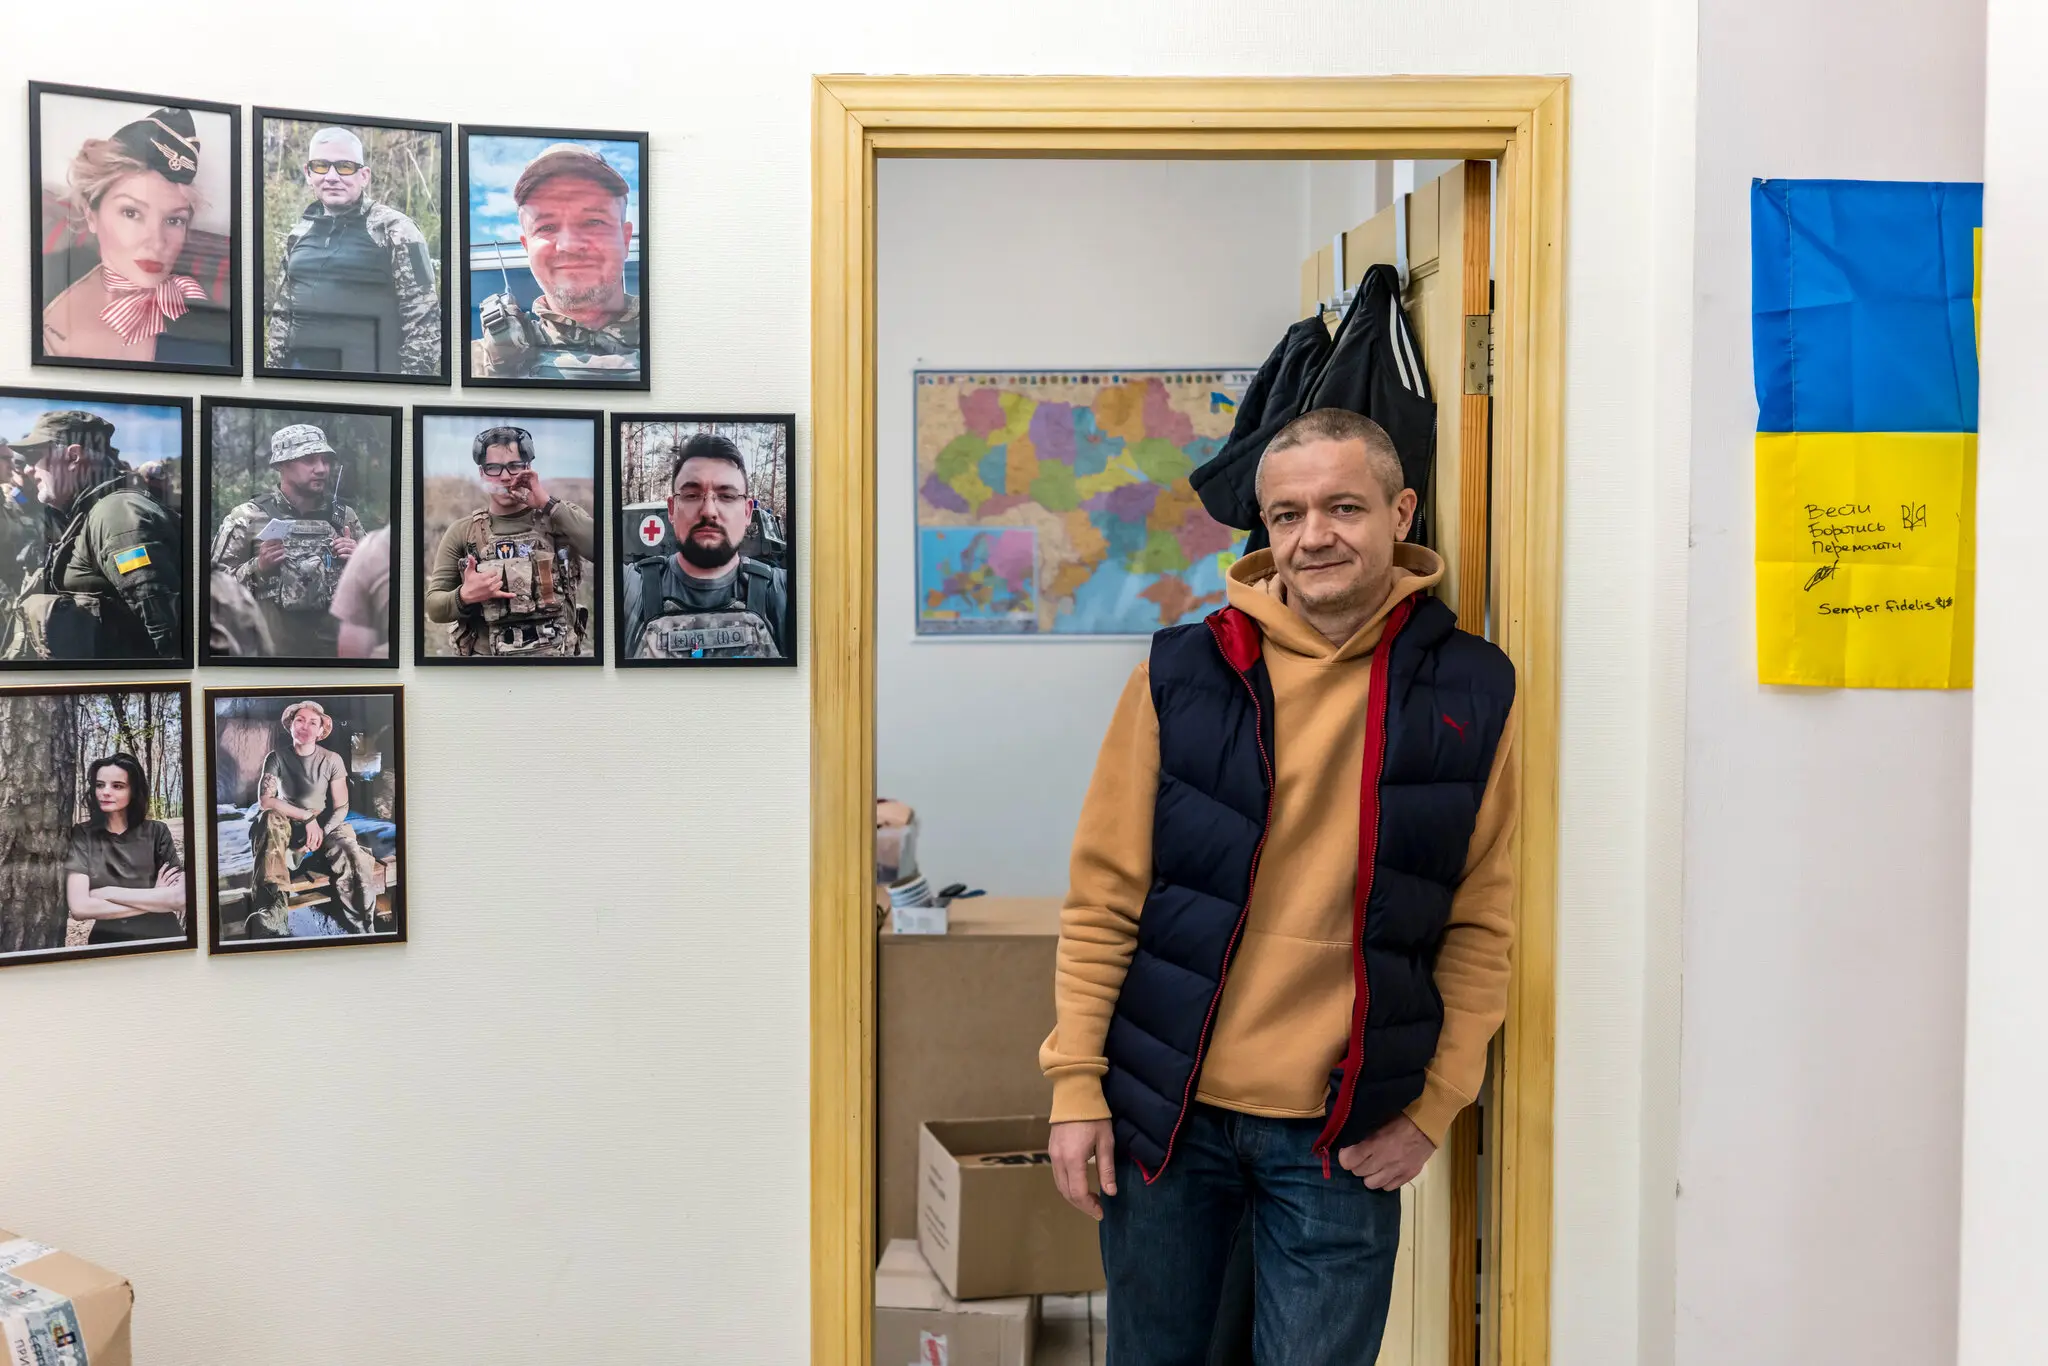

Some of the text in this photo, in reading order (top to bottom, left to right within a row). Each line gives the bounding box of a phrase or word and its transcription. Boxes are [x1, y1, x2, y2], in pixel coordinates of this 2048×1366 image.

[1804, 503, 1871, 520] Вести
[1808, 521, 1886, 543] Боротись
[1811, 540, 1902, 559] Перемагати
[1817, 602, 1880, 619] Semper
